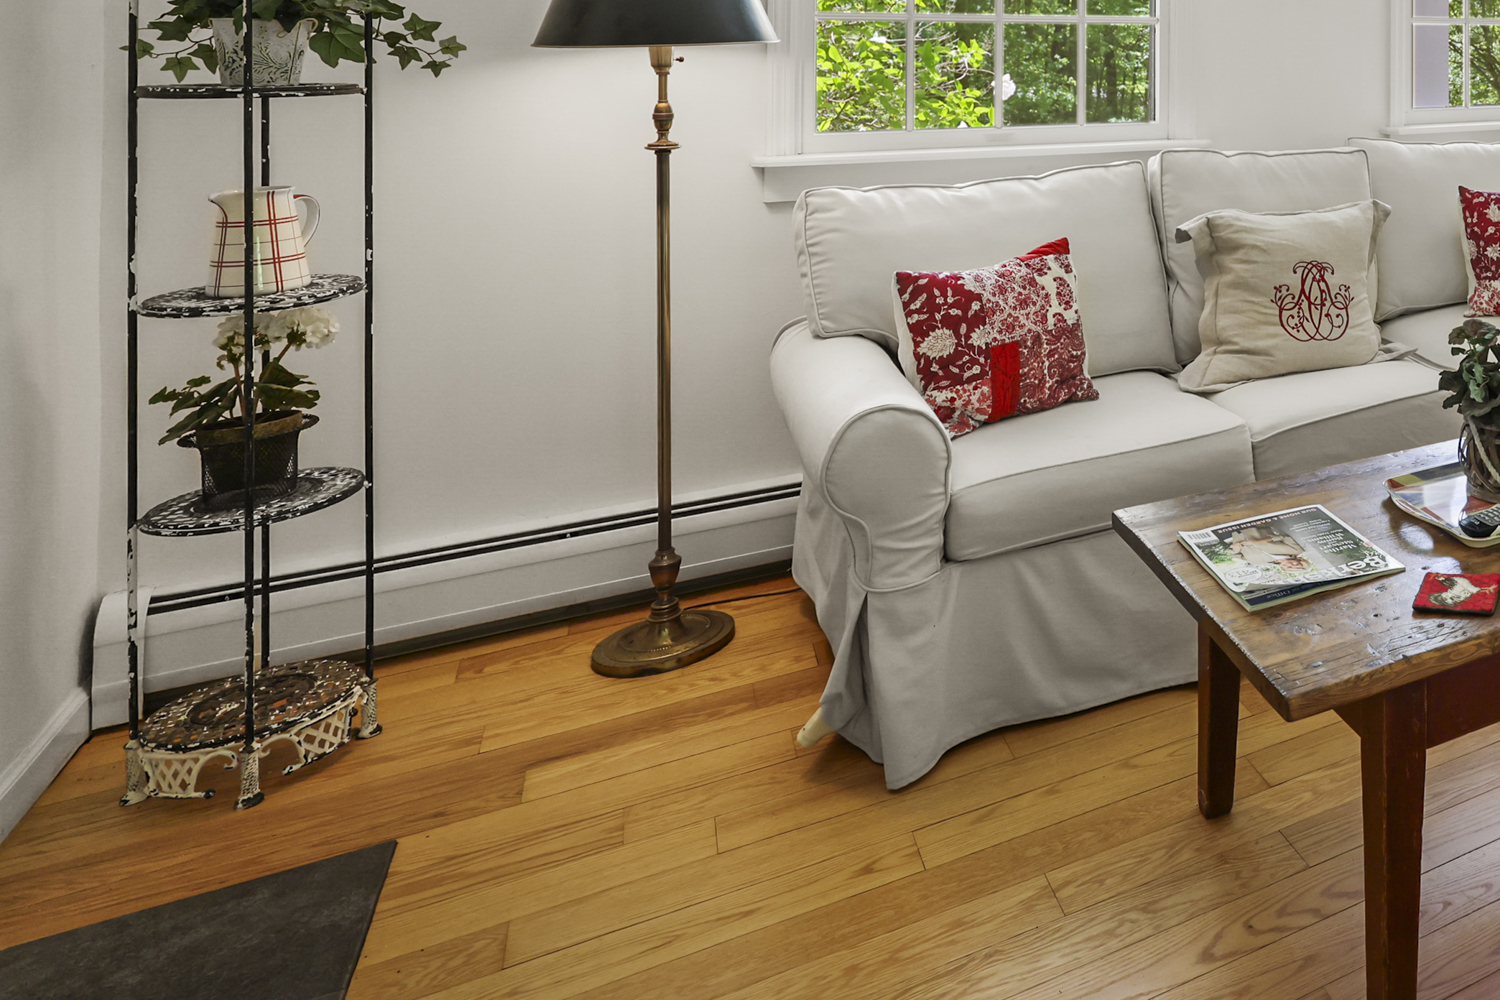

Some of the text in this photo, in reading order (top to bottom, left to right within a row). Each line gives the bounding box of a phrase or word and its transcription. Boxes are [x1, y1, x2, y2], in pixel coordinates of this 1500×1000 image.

[1279, 511, 1300, 520] HOME
[1240, 518, 1272, 528] GARDEN
[1217, 525, 1240, 534] ISSUE
[1266, 590, 1290, 598] Office
